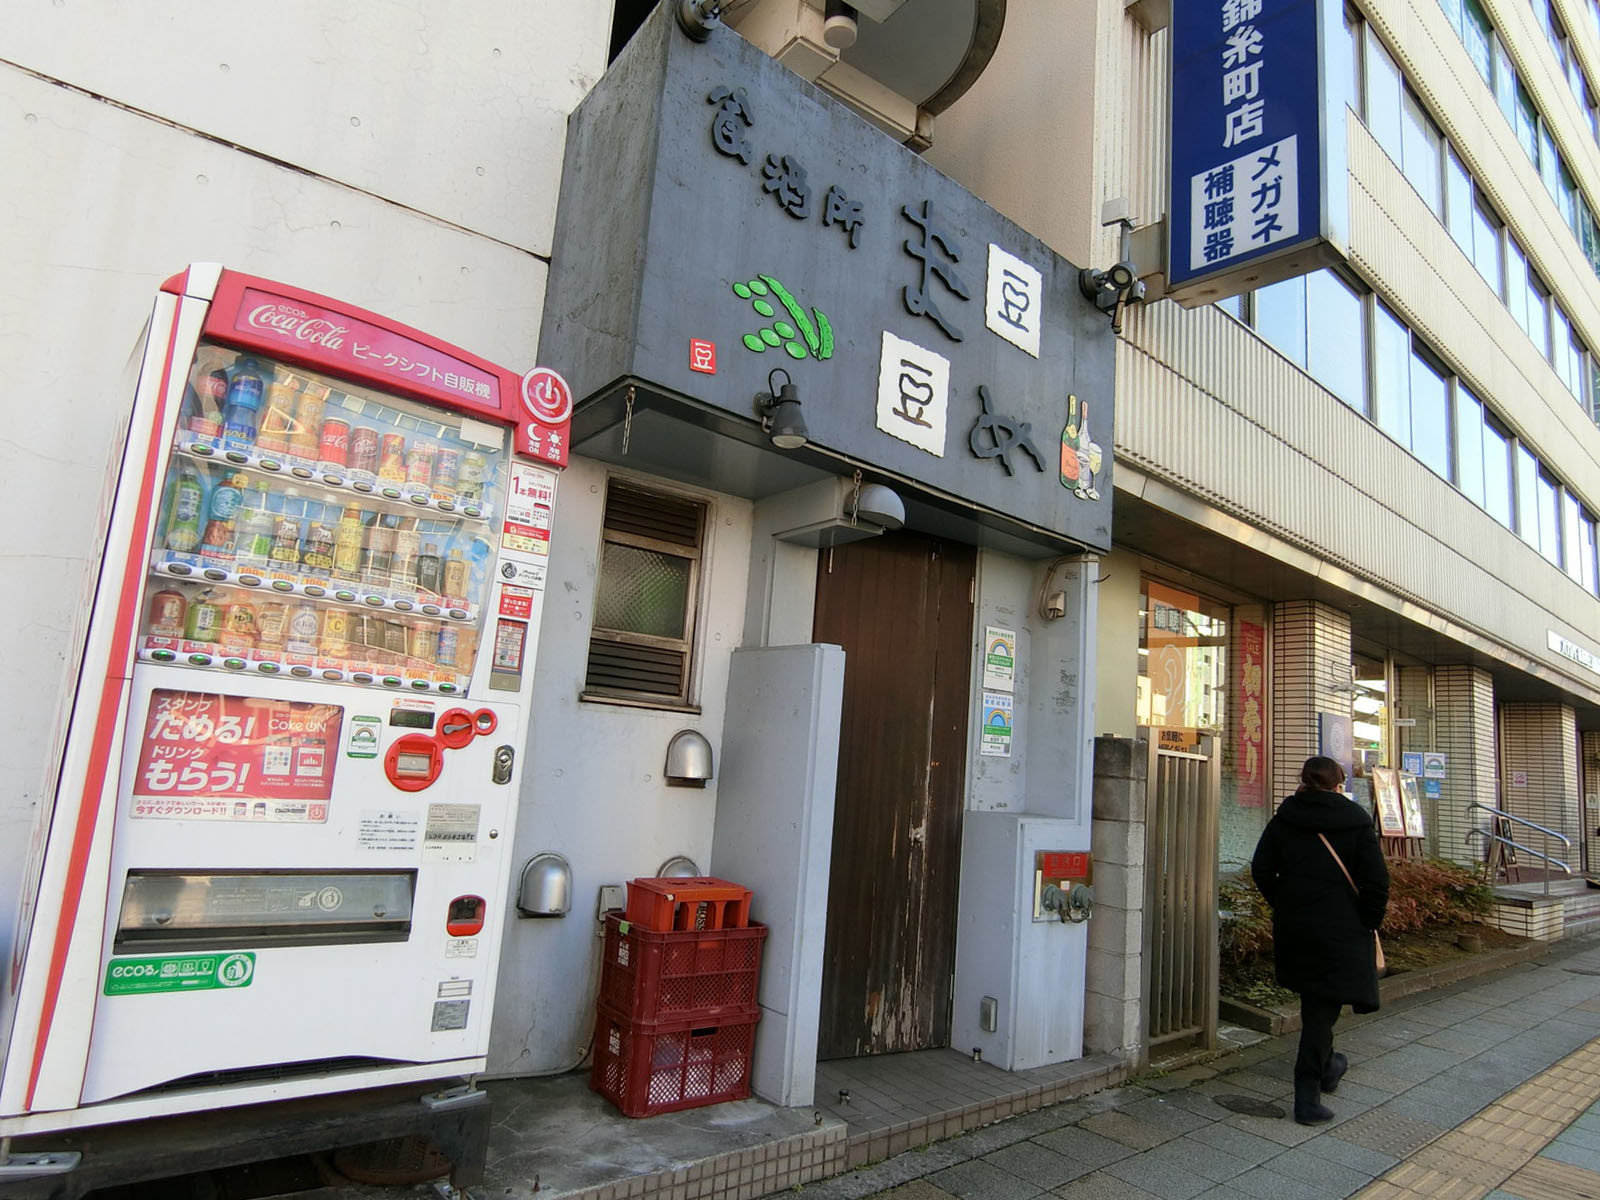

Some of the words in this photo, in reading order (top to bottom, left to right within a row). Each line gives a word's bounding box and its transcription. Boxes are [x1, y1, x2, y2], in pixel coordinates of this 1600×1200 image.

[1222, 0, 1264, 148] 錦糸町店
[1251, 145, 1283, 243] メガネ
[1203, 164, 1235, 263] 補聴器
[248, 304, 350, 351] Coca-Cola
[352, 342, 491, 399] ピークシフト自販機
[528, 446, 540, 455] ON
[547, 452, 561, 461] OFF
[512, 476, 552, 502] 1本無料!
[158, 697, 213, 712] スタンプ
[149, 711, 254, 745] ためる!
[268, 719, 303, 730] Coke
[305, 721, 327, 733] ON
[152, 745, 206, 760] ドリンク
[145, 760, 250, 792] もらう!
[135, 806, 227, 816] 今すぐダウンロード!!
